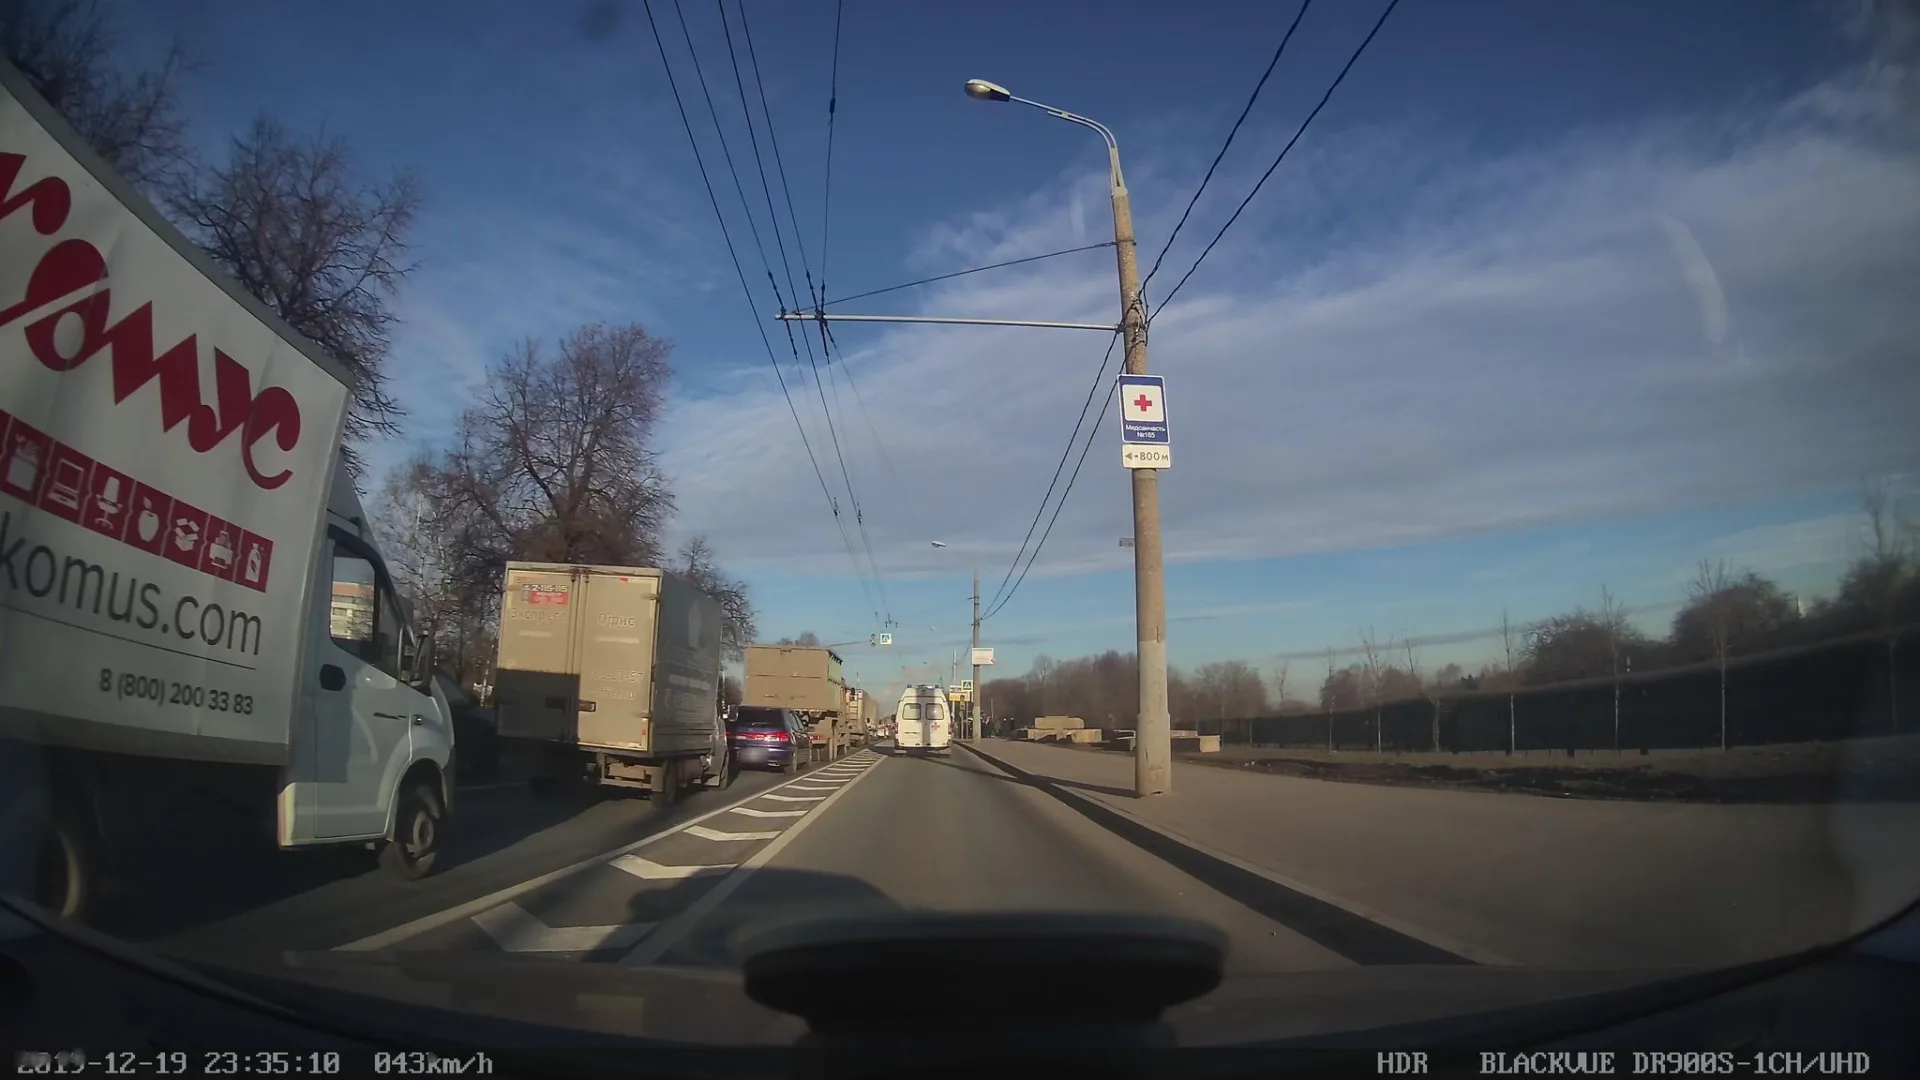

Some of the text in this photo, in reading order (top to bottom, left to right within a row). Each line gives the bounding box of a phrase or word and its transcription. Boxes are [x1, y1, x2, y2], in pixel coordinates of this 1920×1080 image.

[0, 511, 262, 656] komus.com
[598, 612, 636, 628] Офис
[99, 668, 255, 716] 8 (800) 200 33 83
